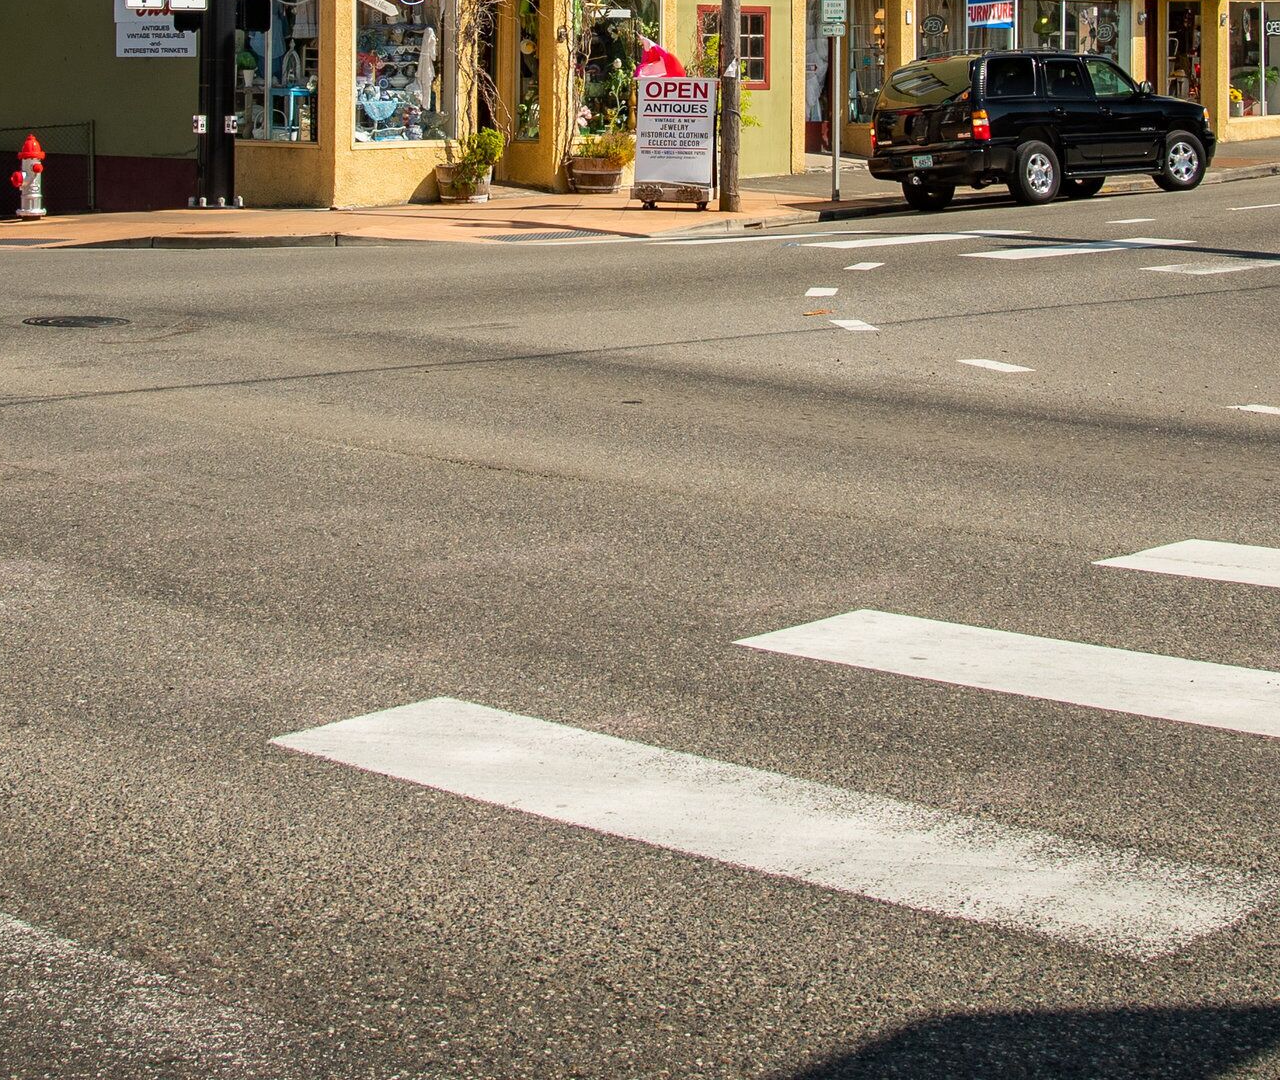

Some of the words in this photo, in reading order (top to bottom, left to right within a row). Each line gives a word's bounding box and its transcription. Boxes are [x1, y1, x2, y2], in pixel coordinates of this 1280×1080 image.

[645, 81, 708, 99] OPEN
[644, 103, 707, 114] ANTIQUES
[648, 139, 677, 147] ECLECTIC
